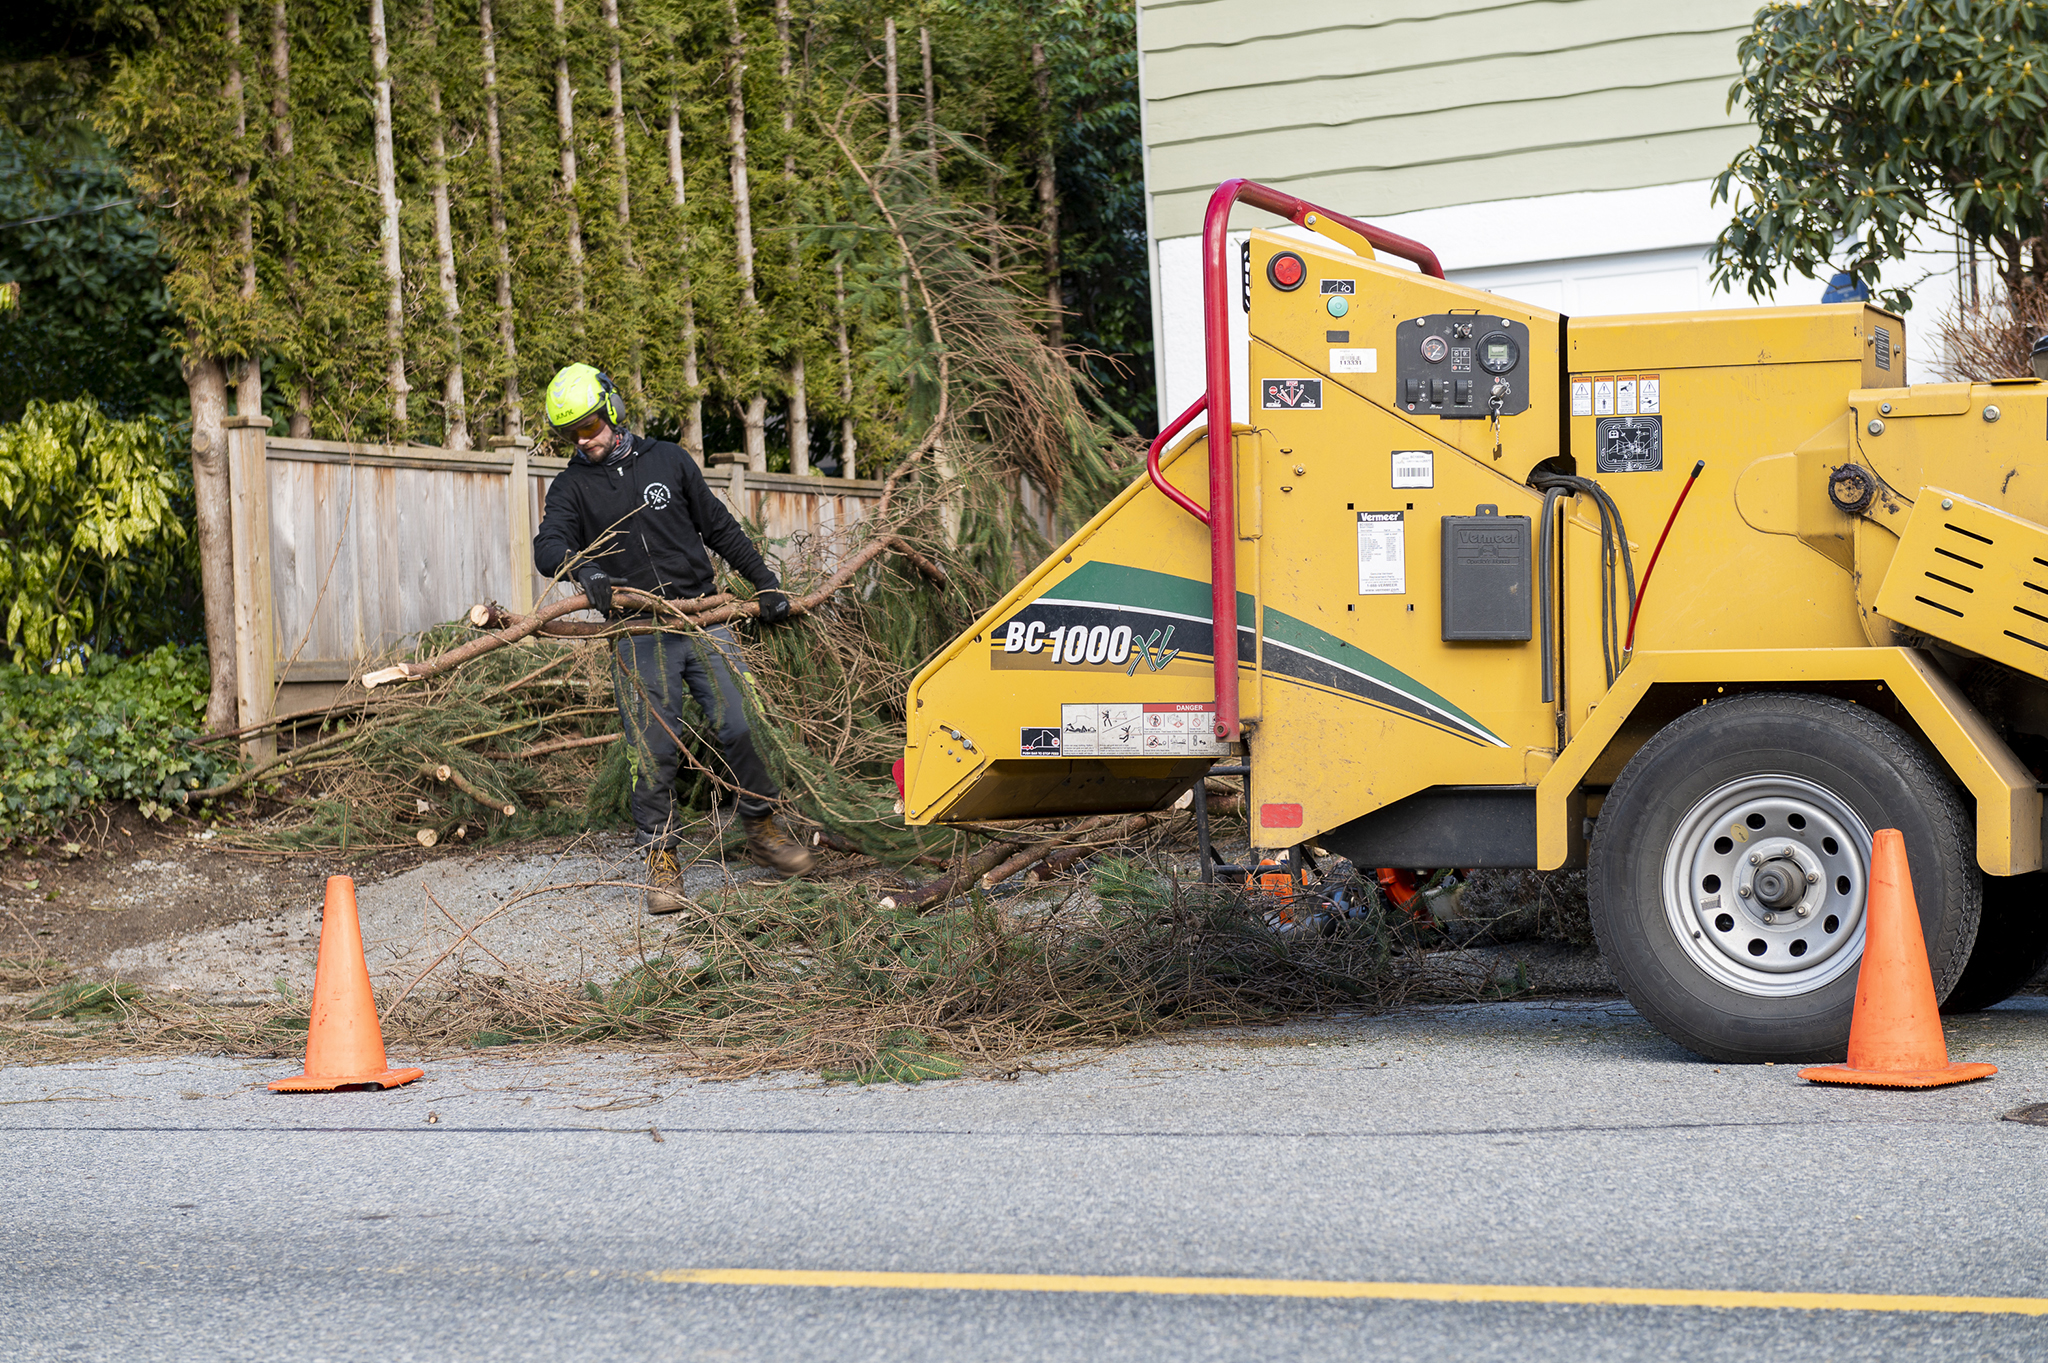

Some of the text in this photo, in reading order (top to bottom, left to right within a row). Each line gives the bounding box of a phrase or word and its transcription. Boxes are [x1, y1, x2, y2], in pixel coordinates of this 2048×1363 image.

[1361, 512, 1399, 521] Vermeer
[1460, 531, 1517, 544] Vermeer
[1004, 621, 1180, 677] BC 1000 XL
